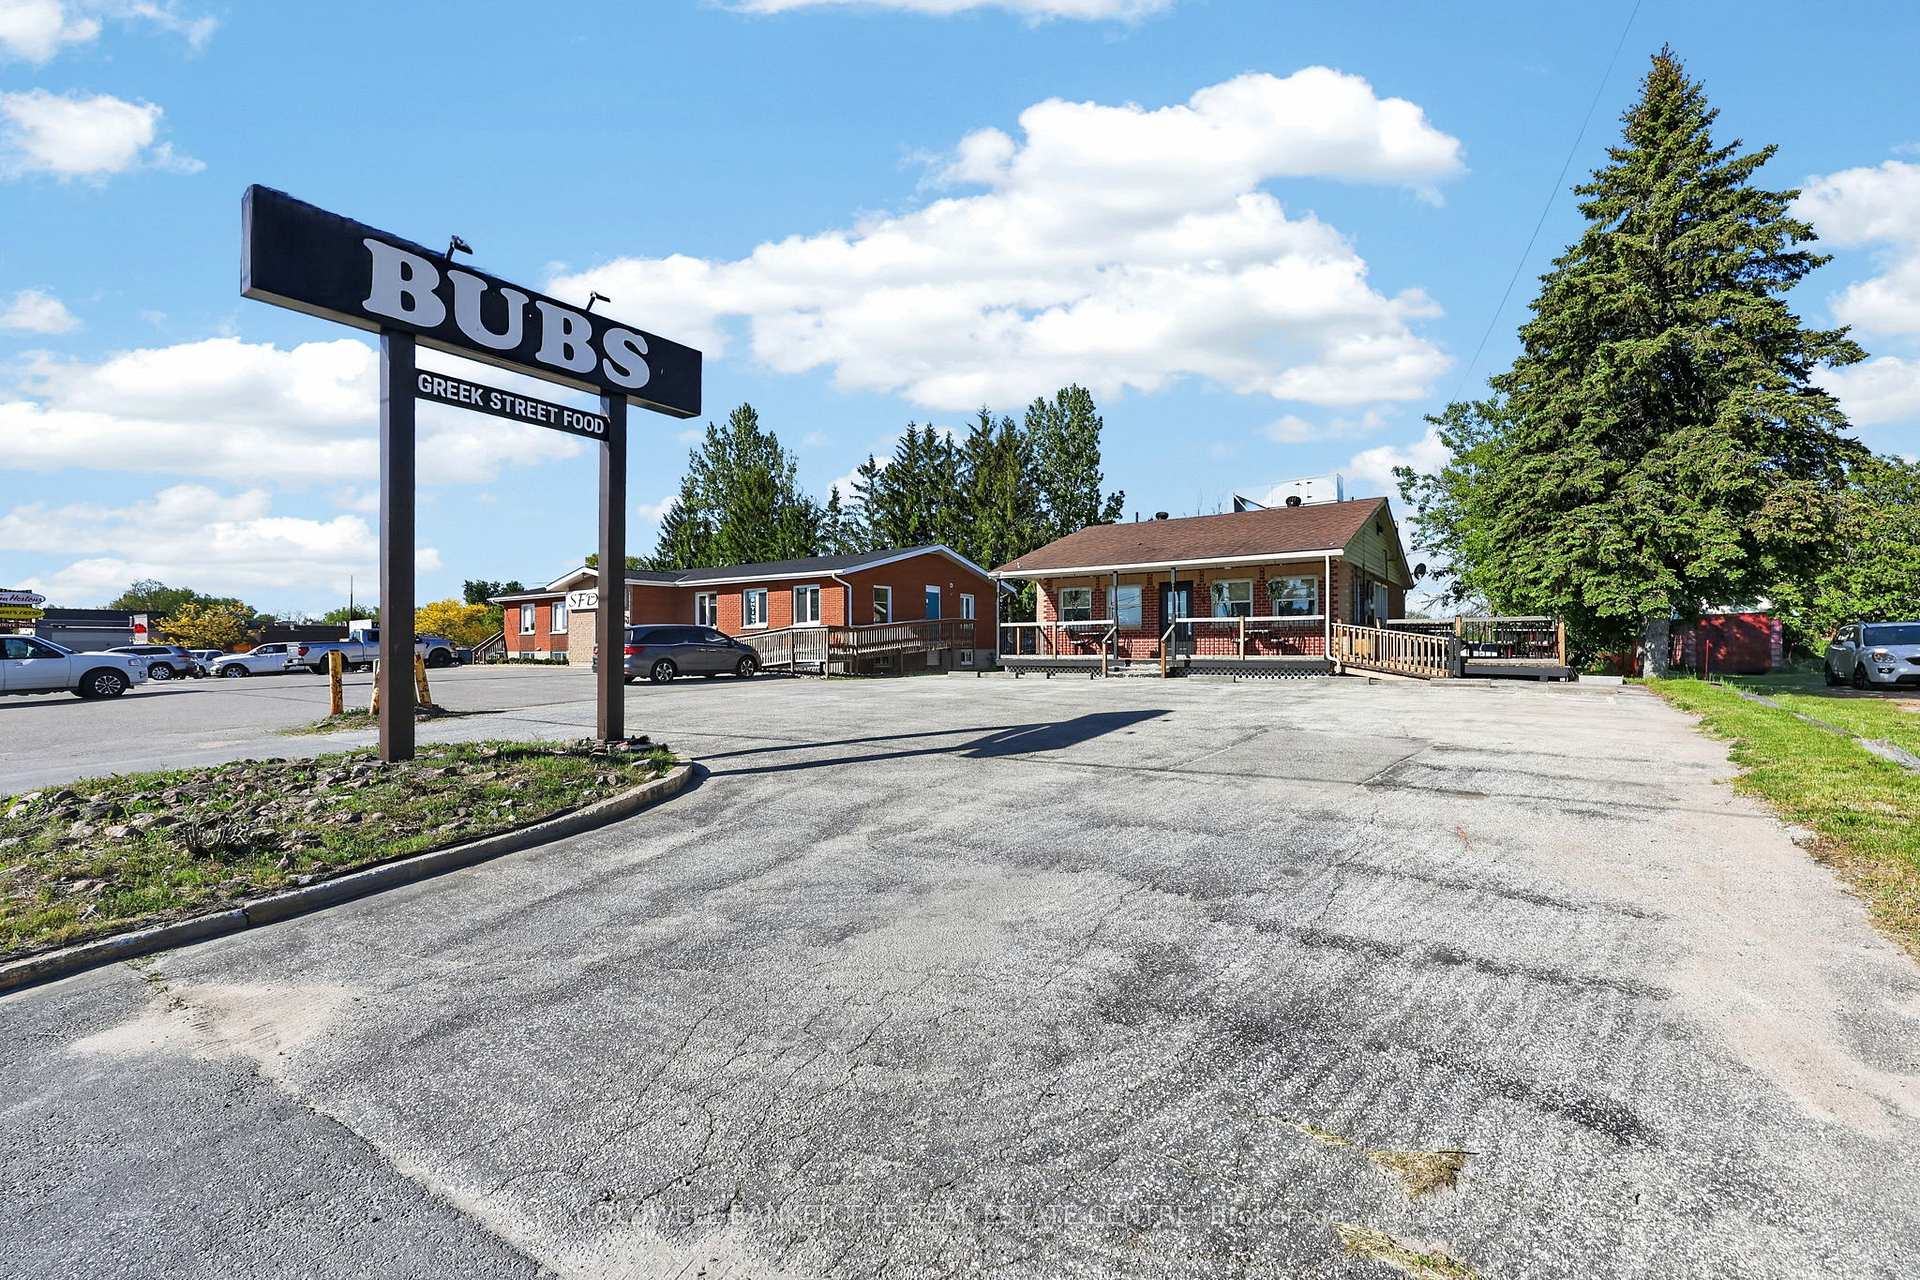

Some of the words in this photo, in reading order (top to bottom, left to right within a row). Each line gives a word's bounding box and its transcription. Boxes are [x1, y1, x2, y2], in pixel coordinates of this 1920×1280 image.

[362, 237, 650, 389] BUBS
[417, 374, 484, 406] GREEK
[489, 392, 558, 424] STREET
[563, 410, 605, 434] FOOD
